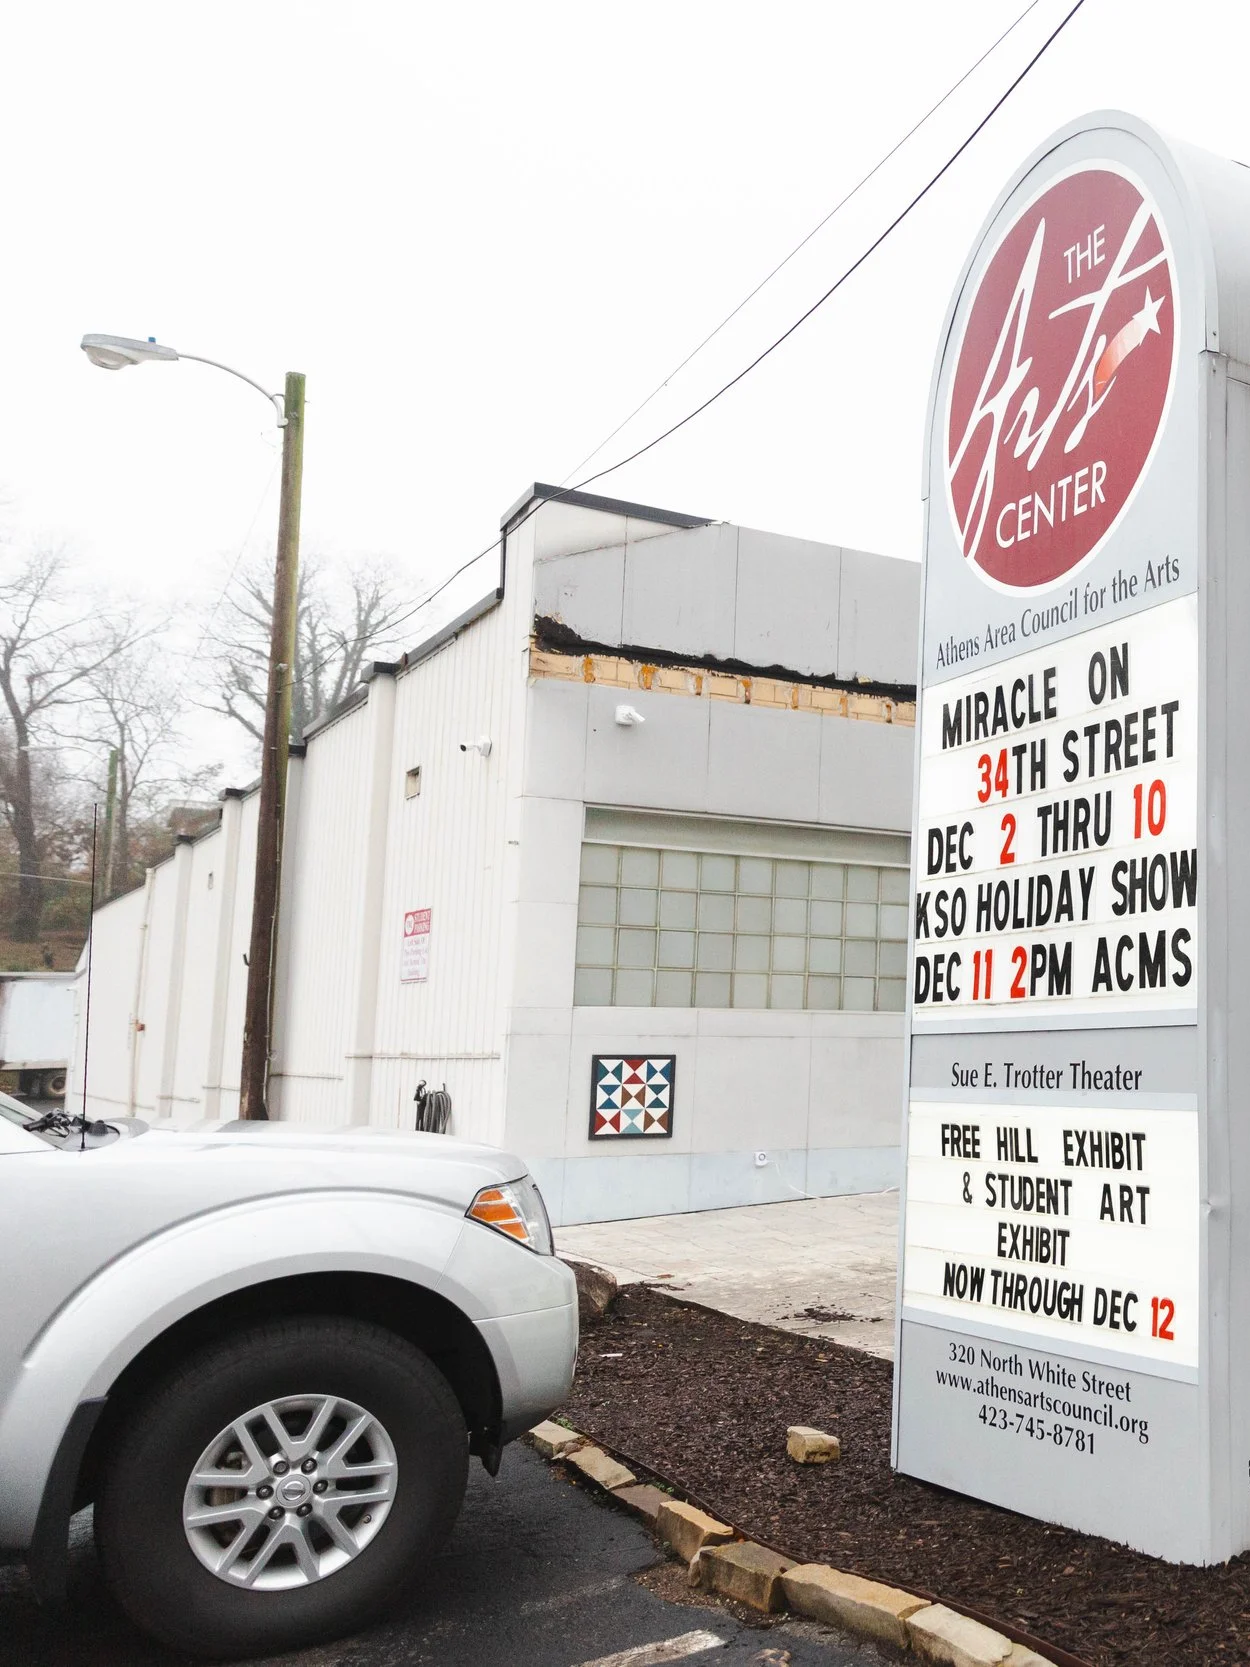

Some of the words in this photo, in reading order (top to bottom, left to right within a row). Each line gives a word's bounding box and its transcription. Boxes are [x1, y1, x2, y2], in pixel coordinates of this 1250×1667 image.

[1063, 224, 1106, 284] THE
[949, 198, 1168, 559] Arts
[996, 460, 1107, 549] CENTER
[936, 635, 980, 669] Athens
[984, 623, 1016, 652] Area
[1021, 591, 1078, 638] Council
[1083, 582, 1107, 615] for
[1111, 570, 1138, 604] the
[1144, 554, 1180, 592] Arts
[942, 666, 1057, 750] MIRACLE
[1088, 642, 1130, 705] ON
[976, 738, 1046, 803] 34TH
[1063, 700, 1180, 783] STREET
[927, 821, 974, 876] DEC
[1000, 813, 1017, 865] 2
[1037, 791, 1112, 857] THRU
[1134, 779, 1167, 839] 10
[915, 886, 967, 940] KSO
[976, 866, 1095, 933] HOLIDAY
[1111, 848, 1198, 917] SHOW
[914, 946, 961, 1005] DEC
[972, 948, 994, 1000] 11
[1010, 941, 1073, 999] 2PM
[1091, 928, 1192, 993] ACMS
[951, 1062, 978, 1088] Sue
[984, 1063, 997, 1088] E.
[1004, 1062, 1063, 1090] Trotter
[1070, 1060, 1143, 1091] Theater
[941, 1123, 981, 1160] FREE
[996, 1125, 1038, 1164] HILL
[1063, 1129, 1146, 1171] EXHIBIT
[962, 1171, 973, 1205] &
[985, 1171, 1073, 1217] STUDENT
[1100, 1183, 1150, 1225] ART
[997, 1222, 1070, 1266] EXHIBIT
[943, 1262, 985, 1304] NOW
[991, 1269, 1084, 1322] THROUGH
[1093, 1287, 1139, 1332] DEC
[1151, 1296, 1175, 1341] 12
[936, 1369, 1149, 1444] www.athensartscouncil.org
[949, 1342, 975, 1366] 320
[980, 1348, 1023, 1377] North
[1028, 1358, 1076, 1389] White
[1082, 1370, 1131, 1402] Street
[978, 1404, 1095, 1455] 423-745-8781
